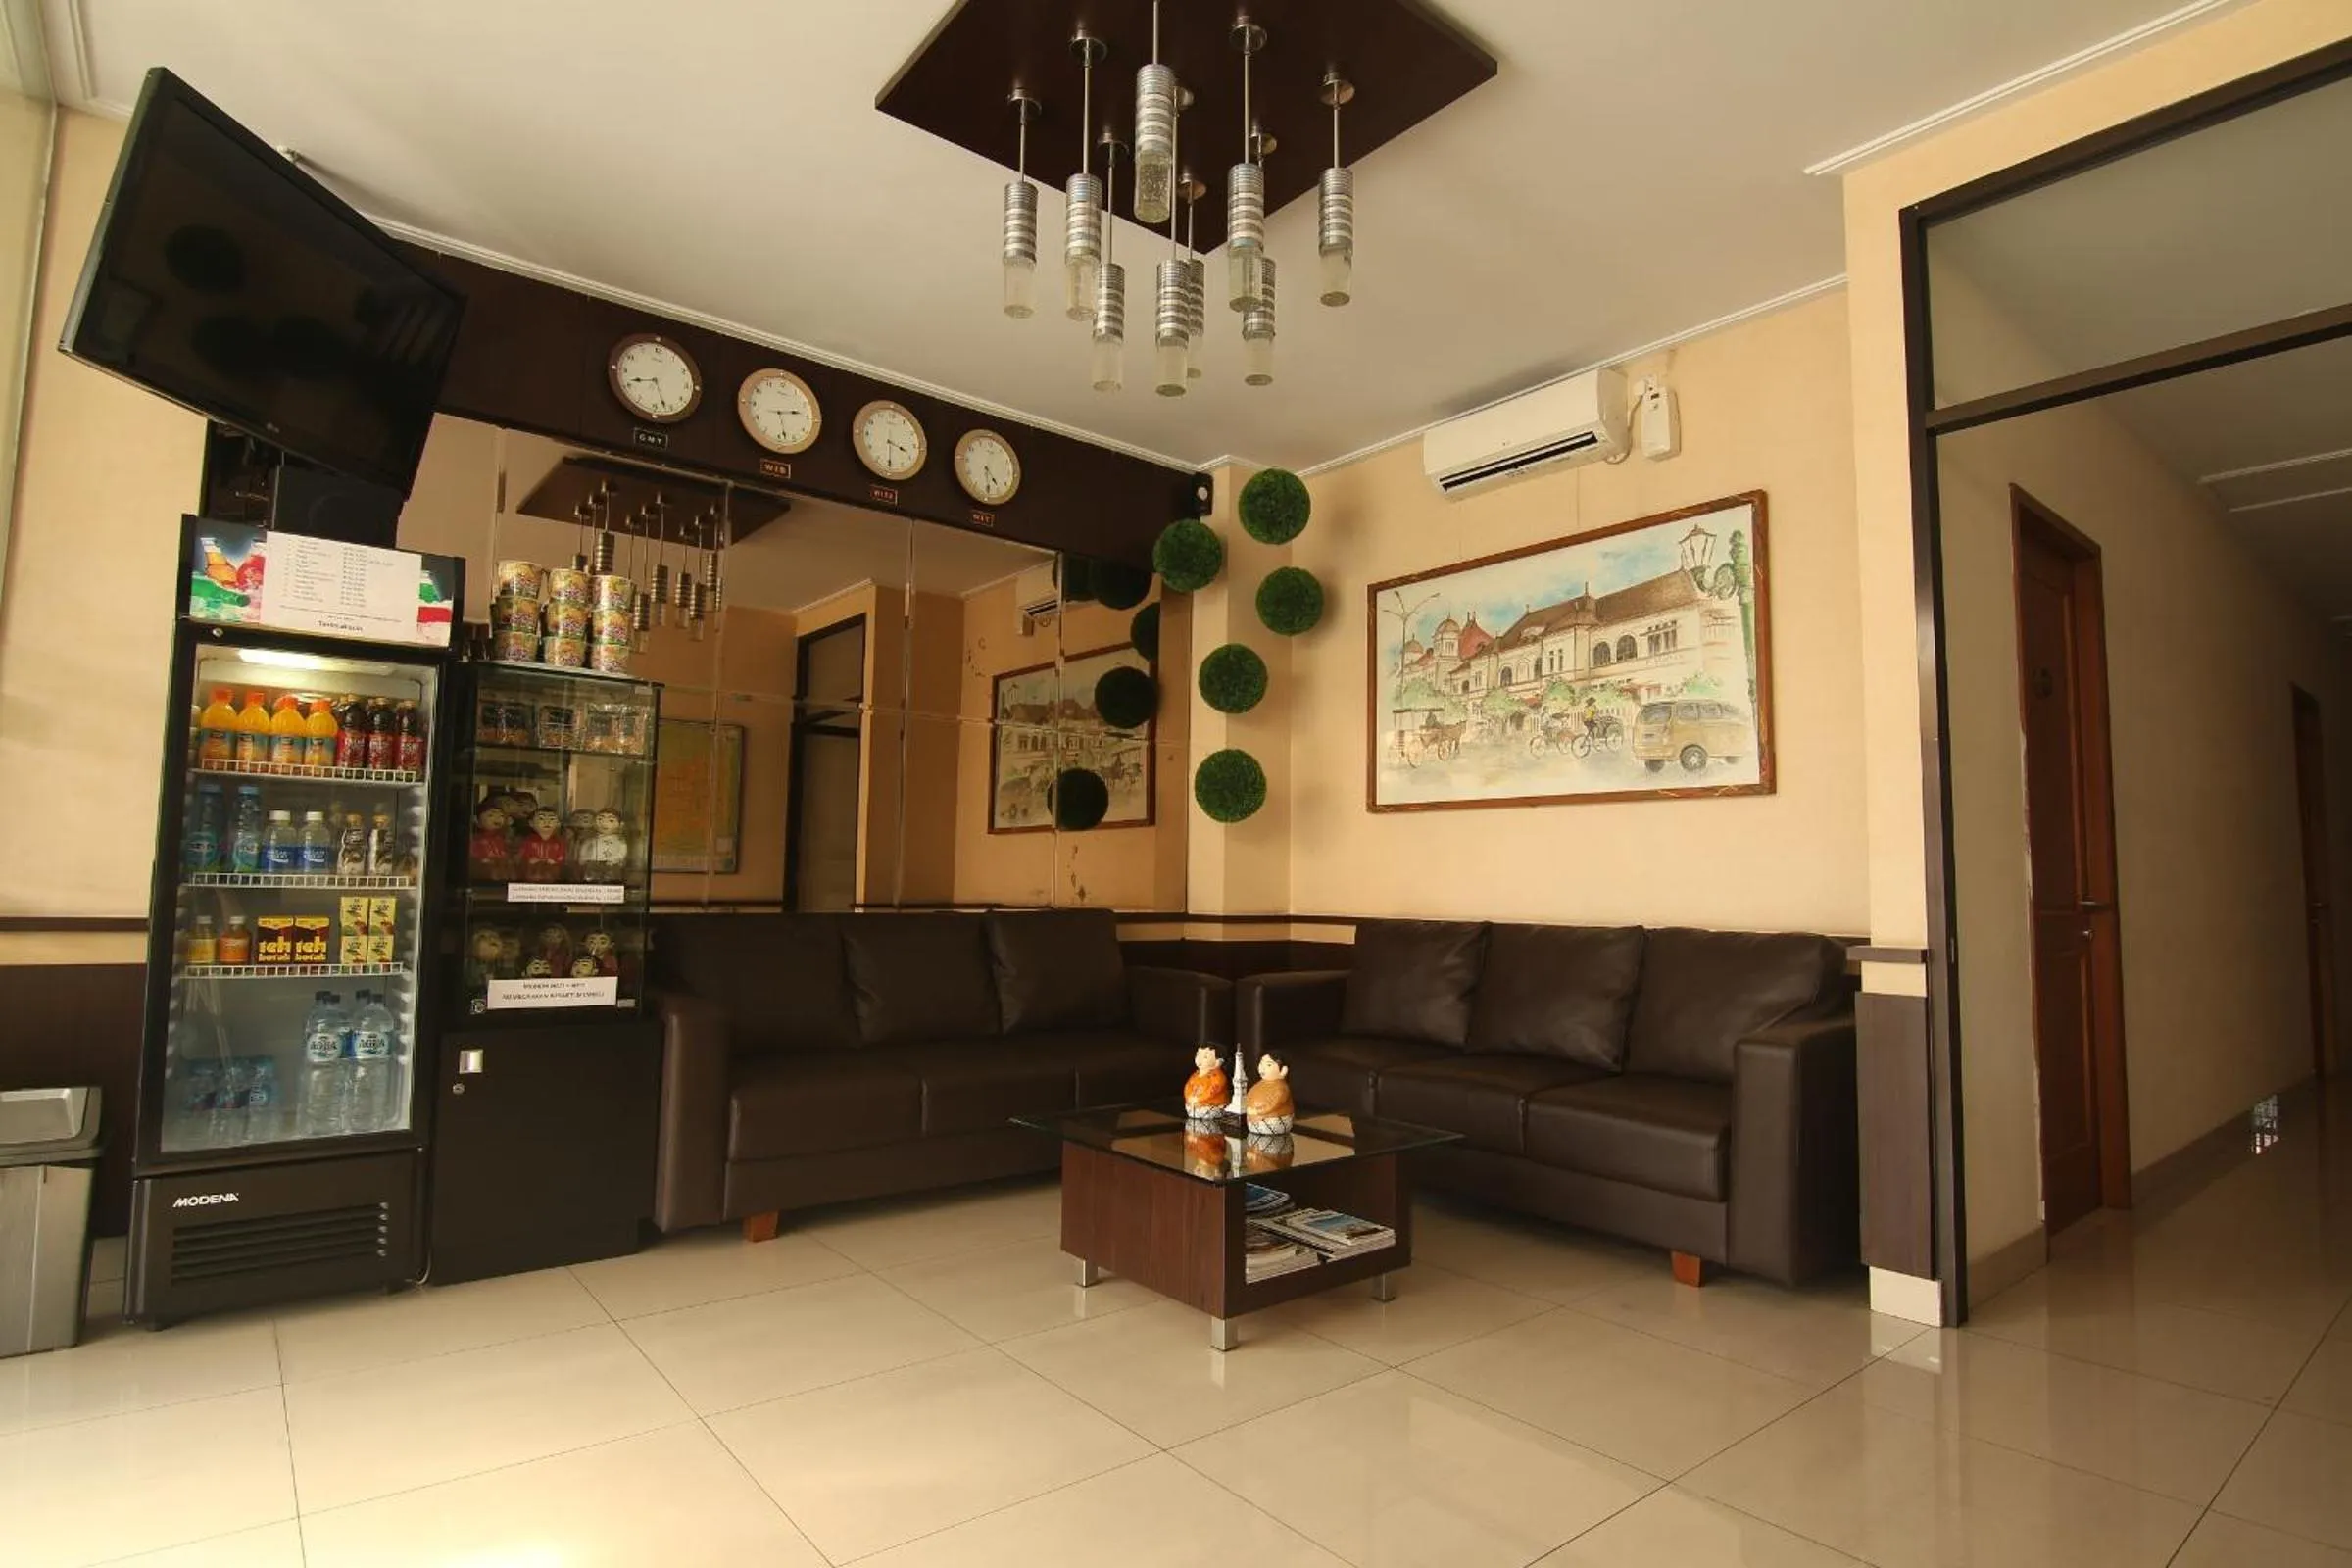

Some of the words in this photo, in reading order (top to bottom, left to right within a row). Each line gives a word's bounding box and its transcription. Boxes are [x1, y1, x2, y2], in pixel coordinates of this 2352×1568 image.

[639, 433, 662, 444] GMT
[259, 936, 291, 953] teh
[295, 936, 326, 953] teh
[172, 1193, 239, 1208] MODENA
